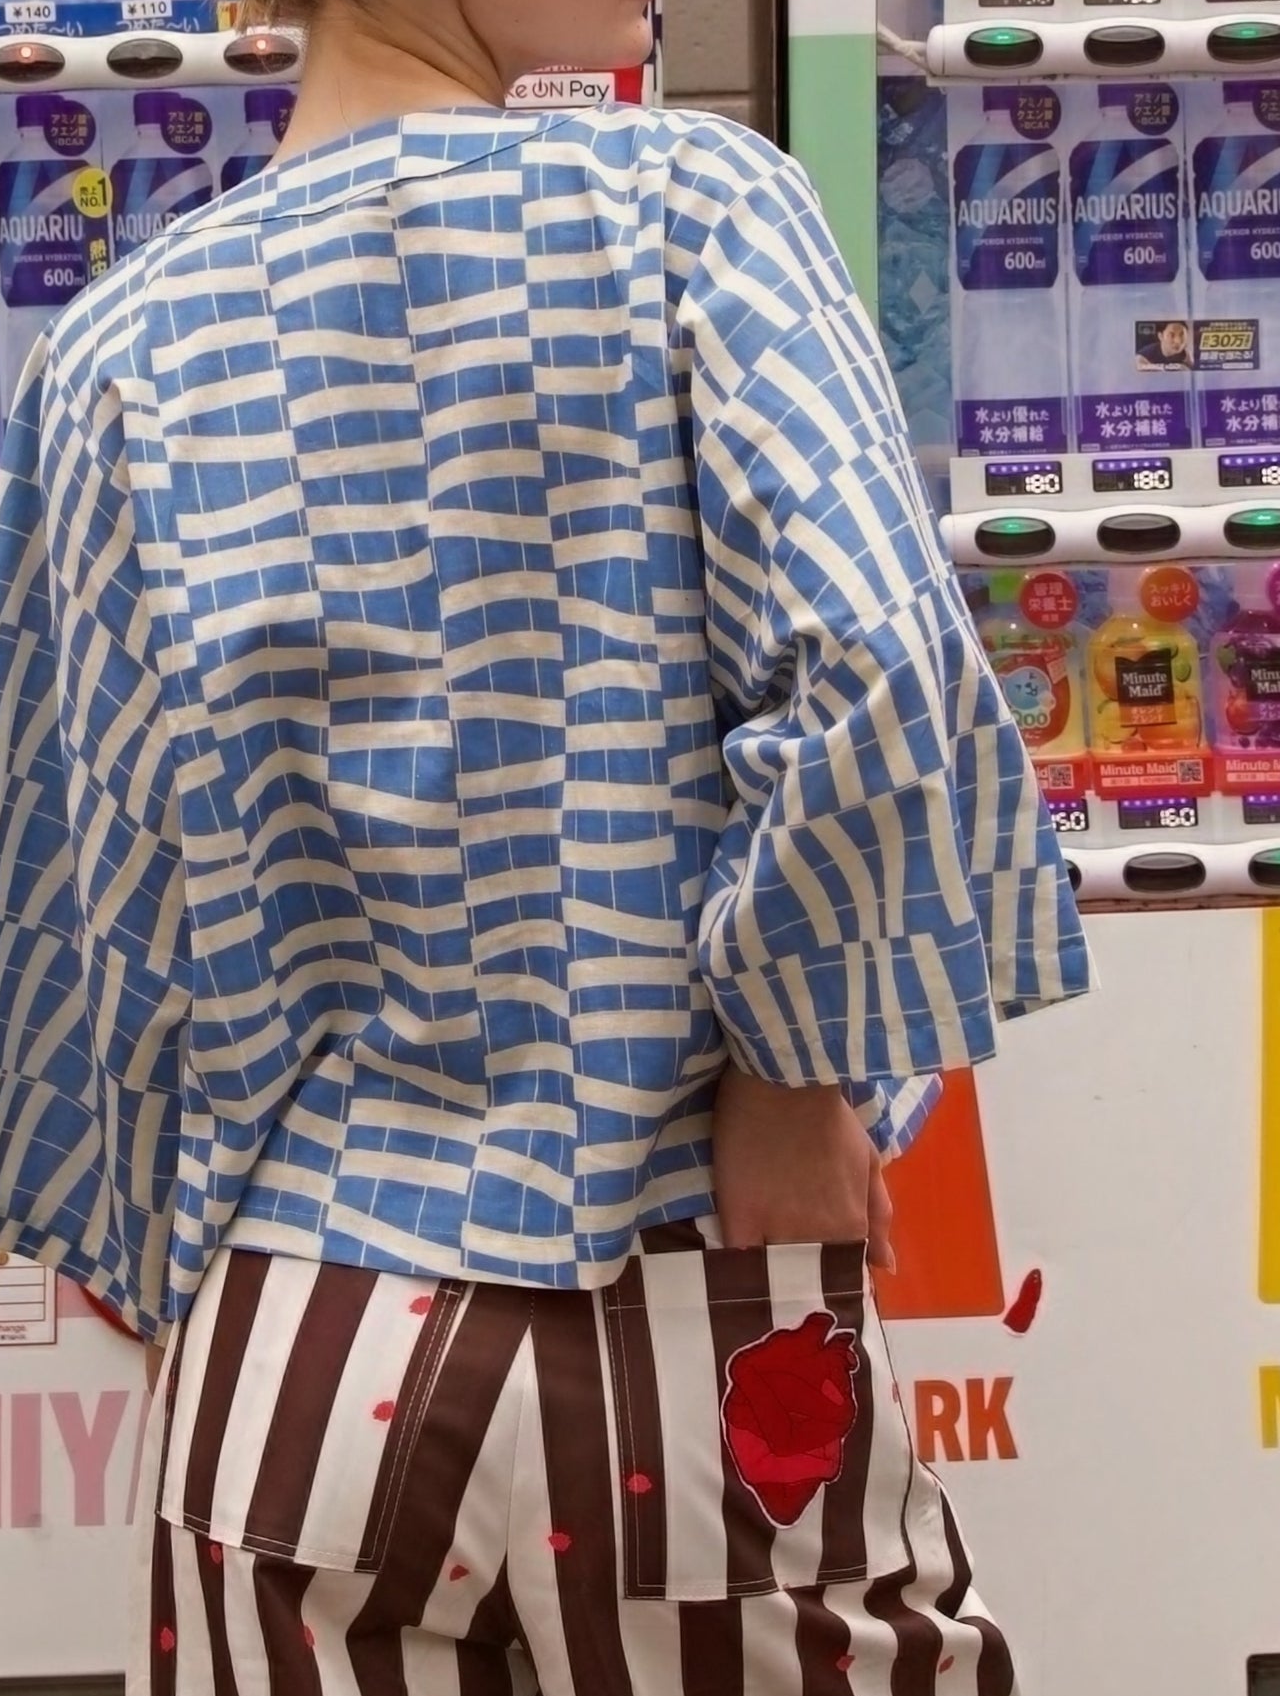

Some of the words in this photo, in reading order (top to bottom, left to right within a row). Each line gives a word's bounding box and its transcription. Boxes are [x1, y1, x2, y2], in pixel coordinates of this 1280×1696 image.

[507, 80, 527, 100] ke
[569, 80, 611, 103] Pay
[957, 198, 1056, 228] AQUARIUS
[1075, 193, 1177, 222] AQUARIUS
[1122, 670, 1168, 686] Minute
[1127, 683, 1163, 698] Maid
[1100, 762, 1143, 776] Minute
[1145, 760, 1177, 775] Maid
[914, 1376, 1019, 1463] RK
